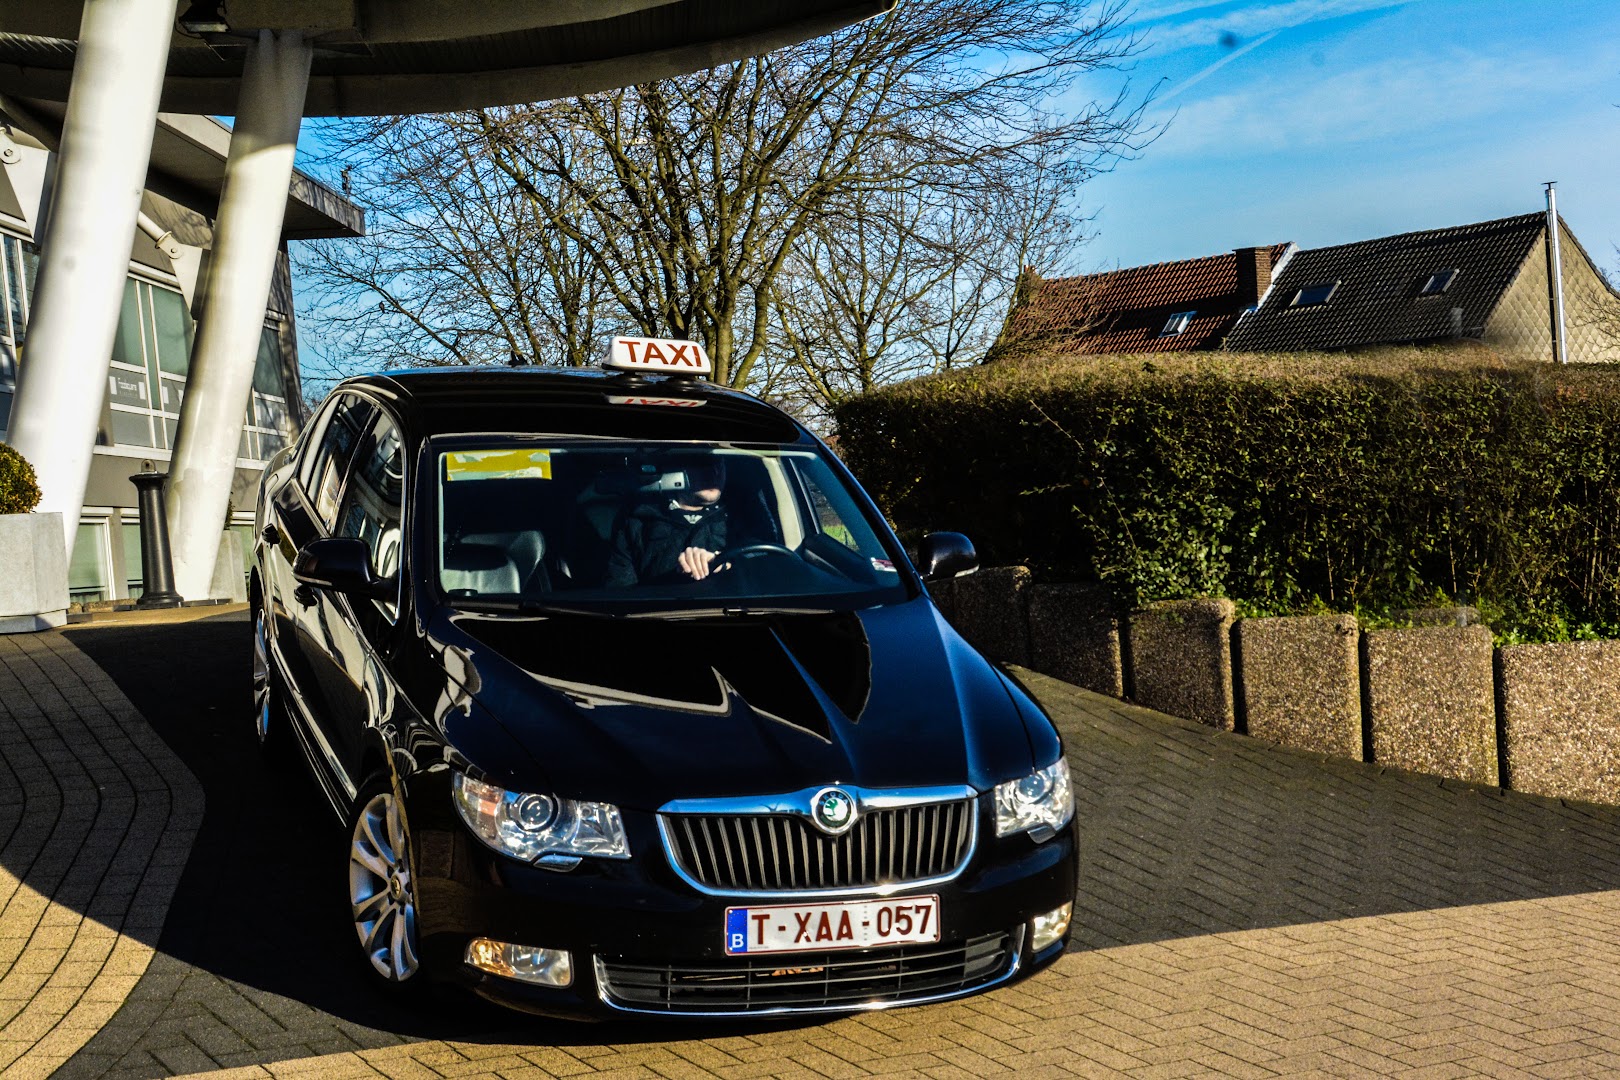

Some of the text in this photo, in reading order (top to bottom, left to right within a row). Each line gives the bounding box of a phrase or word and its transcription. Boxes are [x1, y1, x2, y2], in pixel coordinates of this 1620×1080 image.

[618, 340, 702, 368] TAXI
[751, 904, 932, 945] T-XAA-057
[732, 933, 744, 948] B
